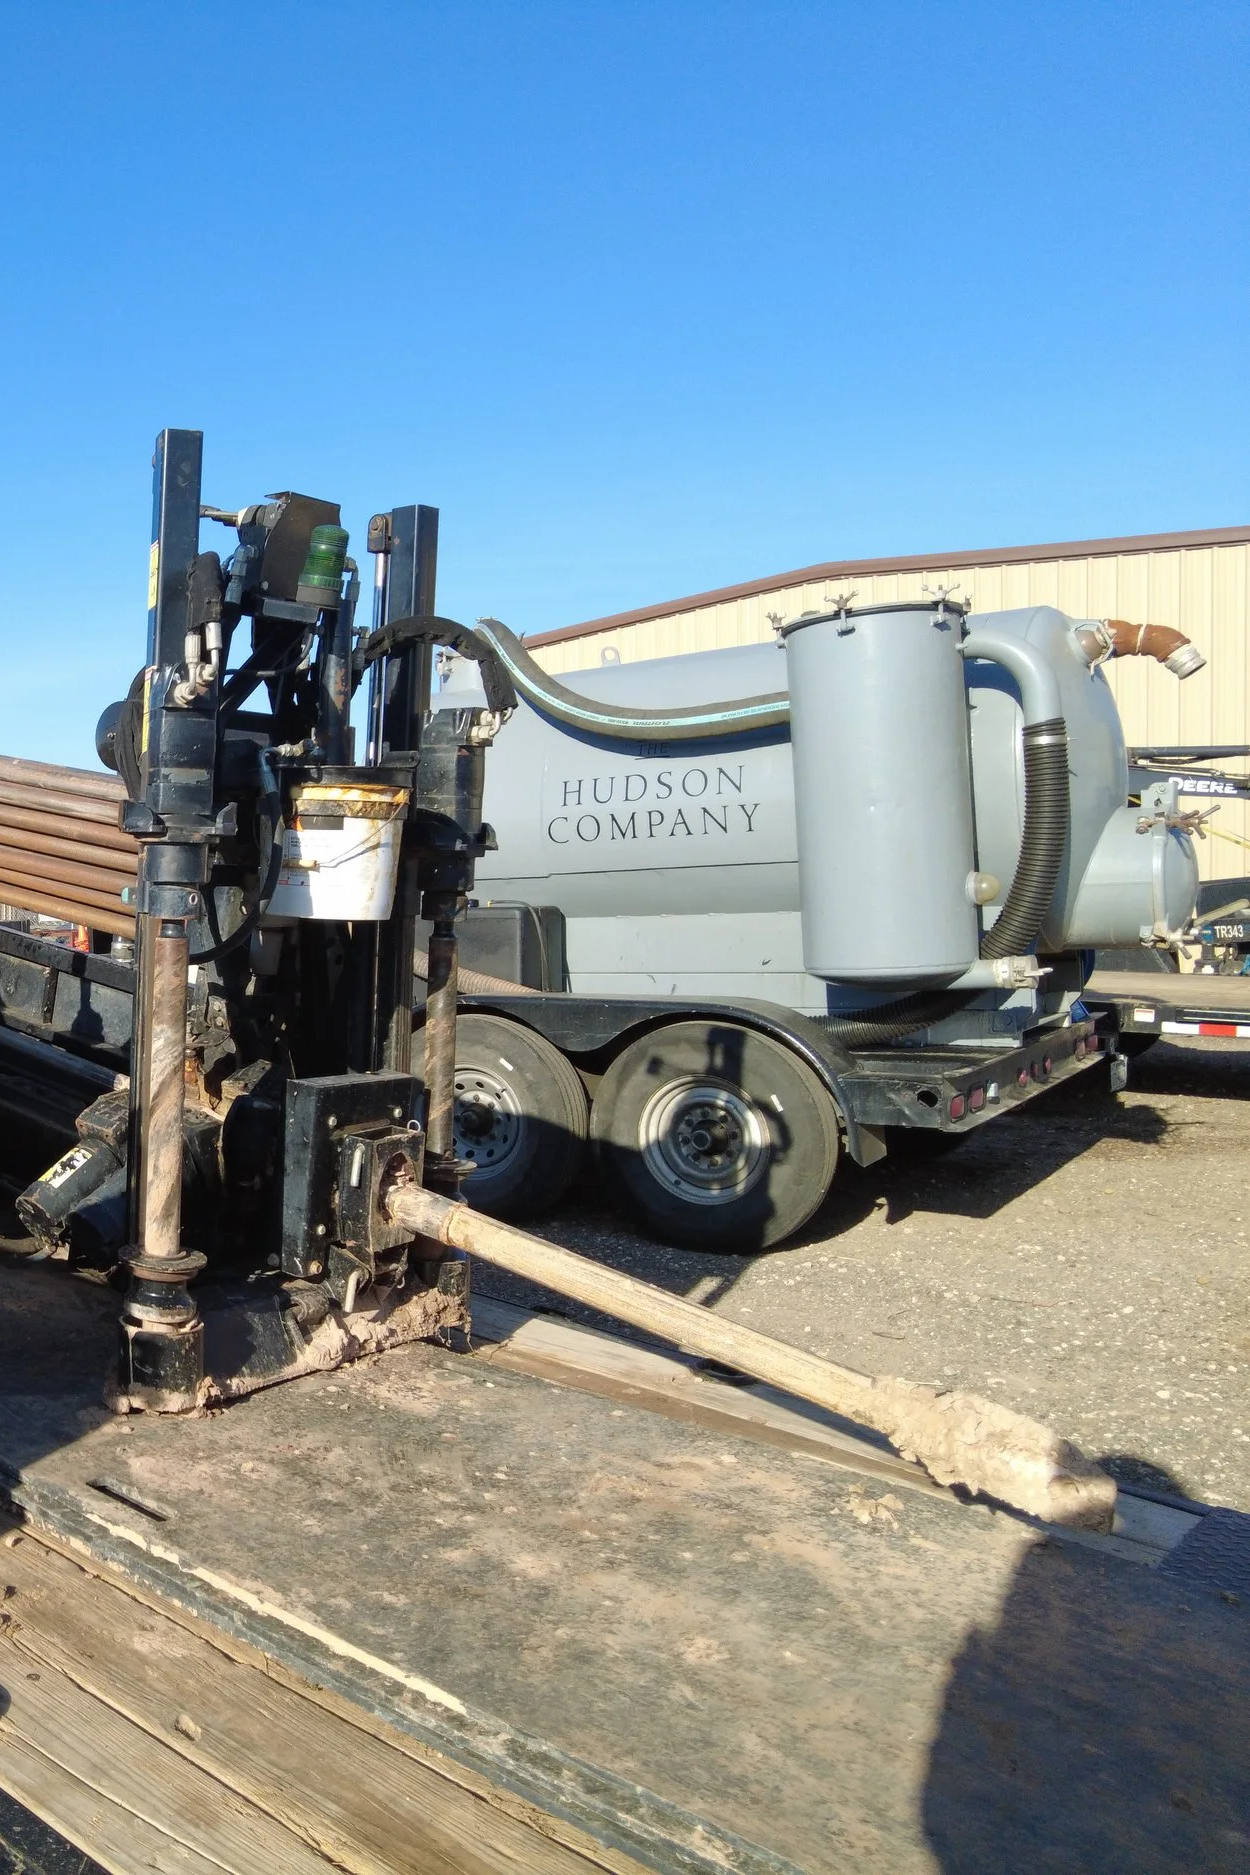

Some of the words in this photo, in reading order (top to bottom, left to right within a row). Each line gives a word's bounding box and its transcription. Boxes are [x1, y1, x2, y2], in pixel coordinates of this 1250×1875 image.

[638, 743, 669, 756] THE
[561, 764, 746, 808] HUDSON
[547, 802, 761, 844] COMPANY
[1214, 924, 1244, 939] TR343
